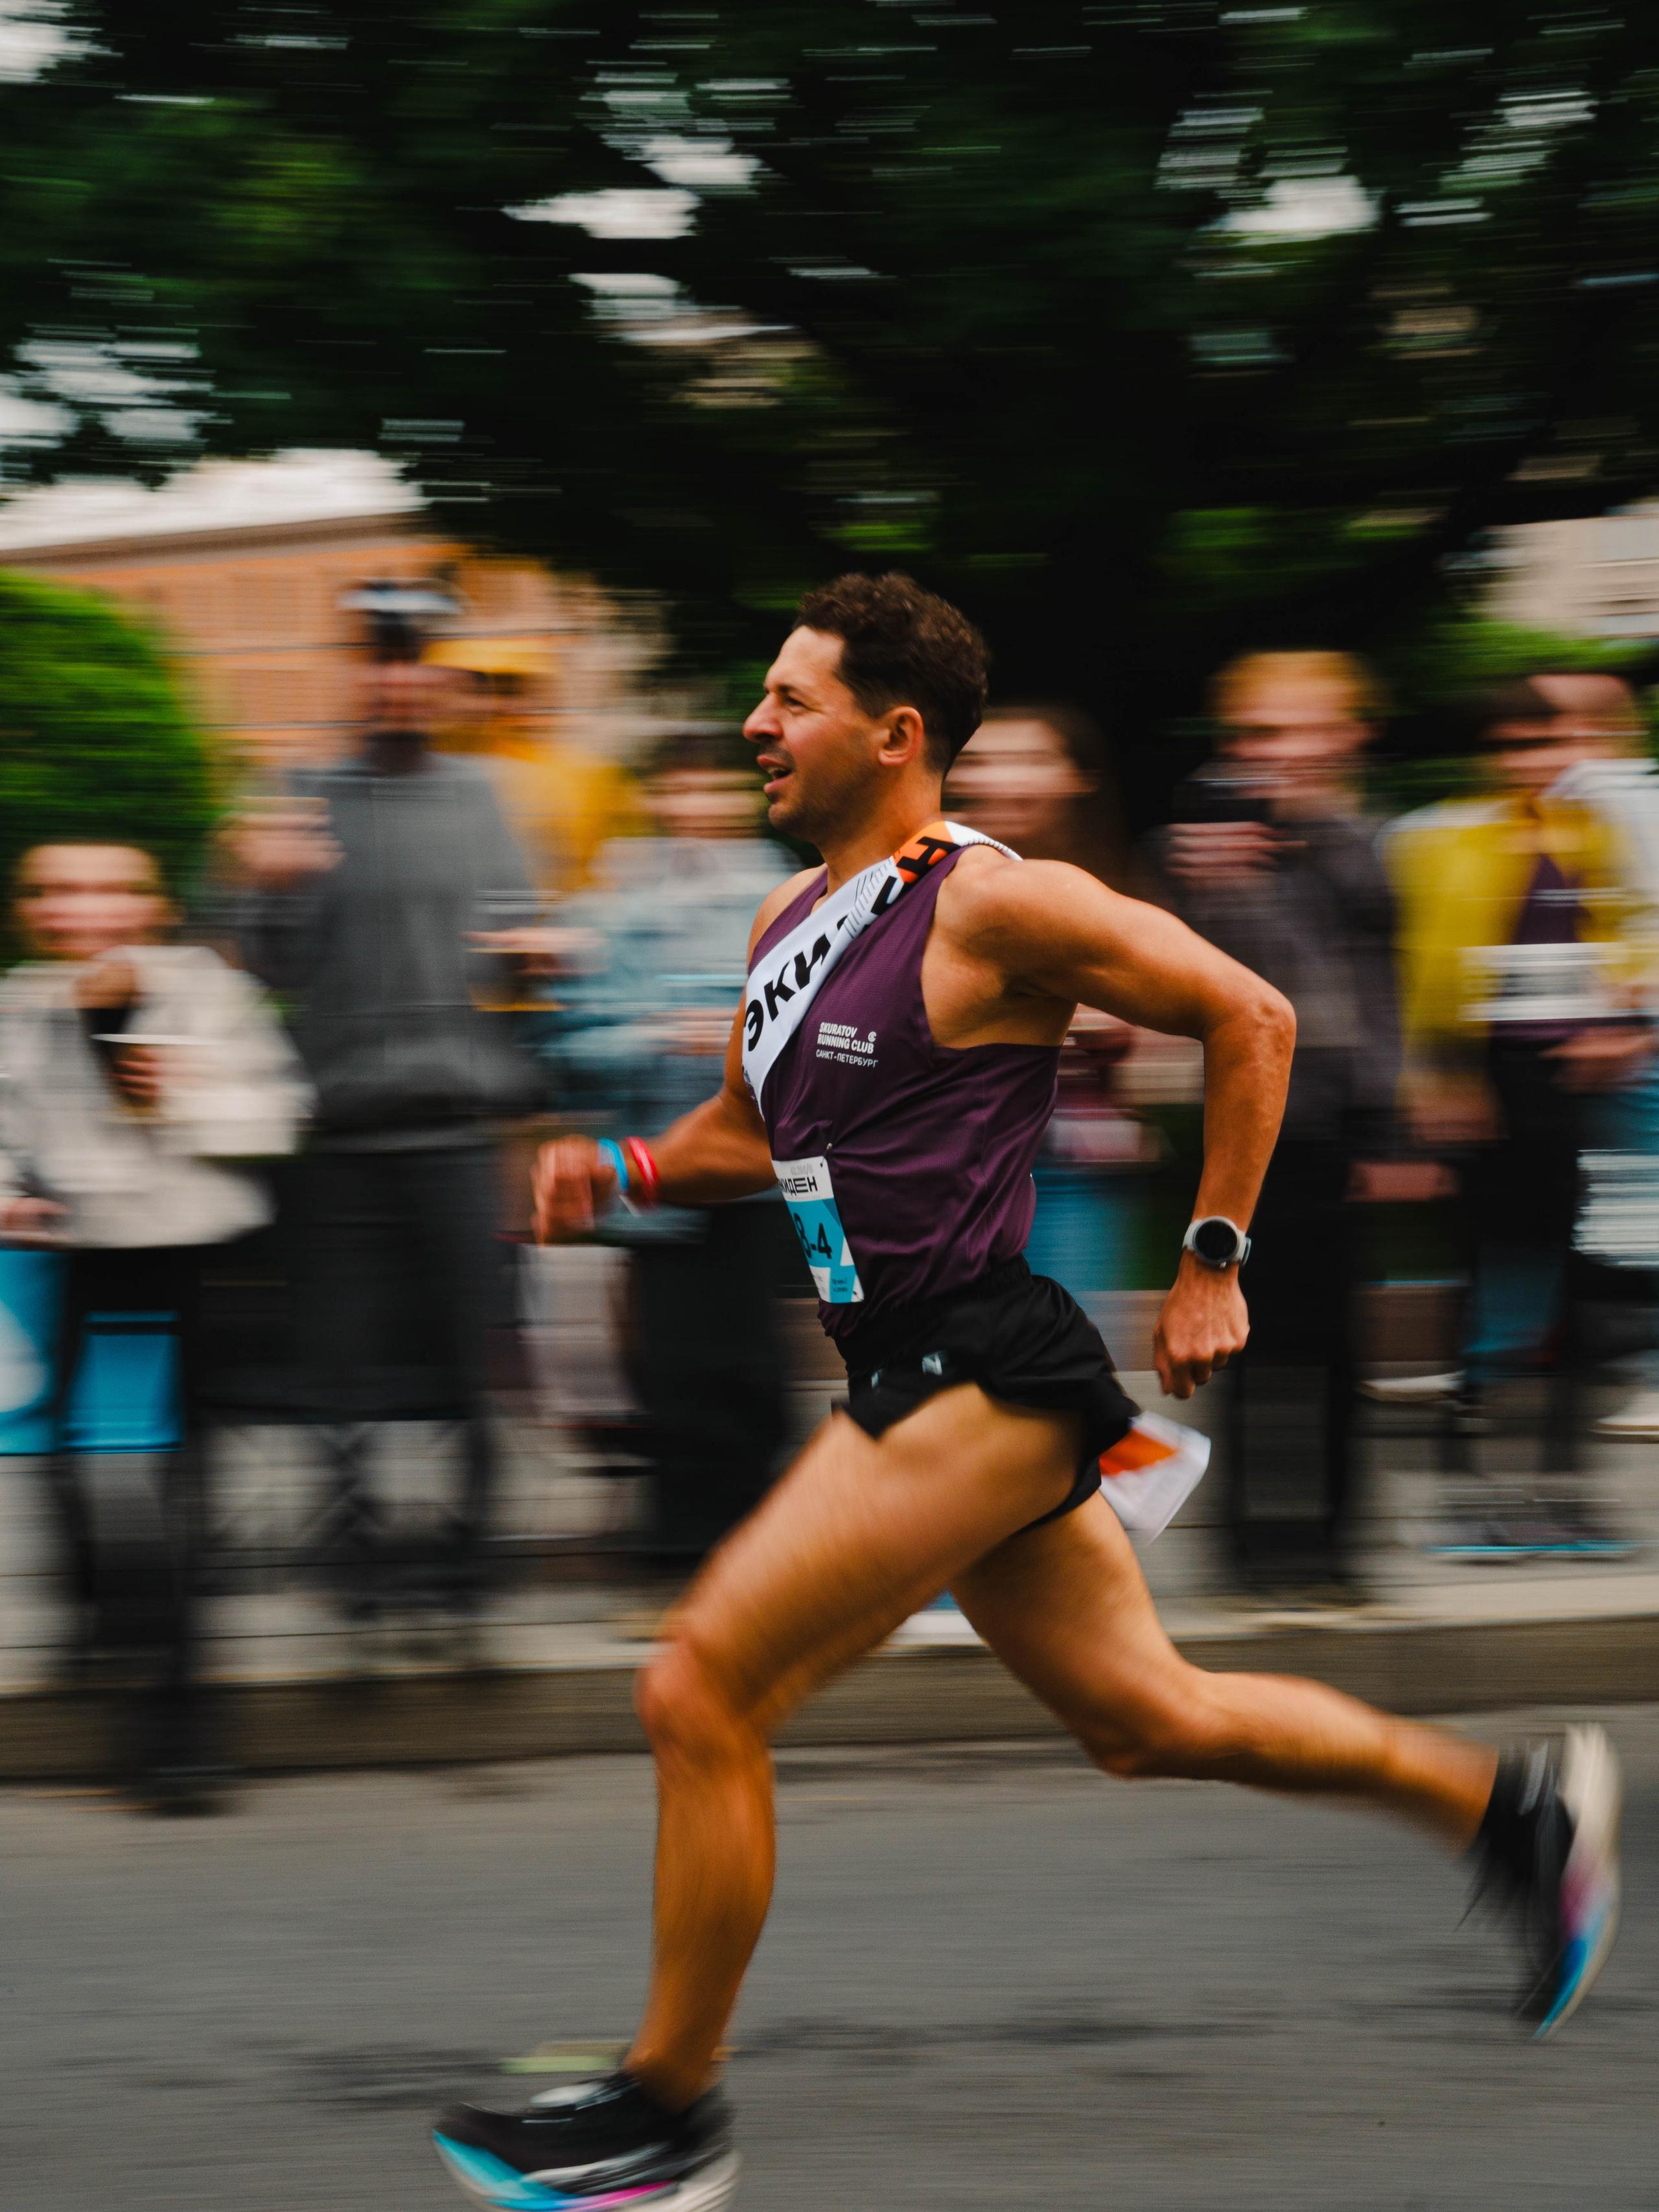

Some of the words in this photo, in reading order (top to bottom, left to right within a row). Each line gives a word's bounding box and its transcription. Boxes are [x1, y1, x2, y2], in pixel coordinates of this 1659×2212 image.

[743, 836, 961, 1052] ЭКИН
[819, 1022, 857, 1038] SKURATOV
[817, 1034, 850, 1049] RUNNING
[851, 1040, 874, 1054] CLUB
